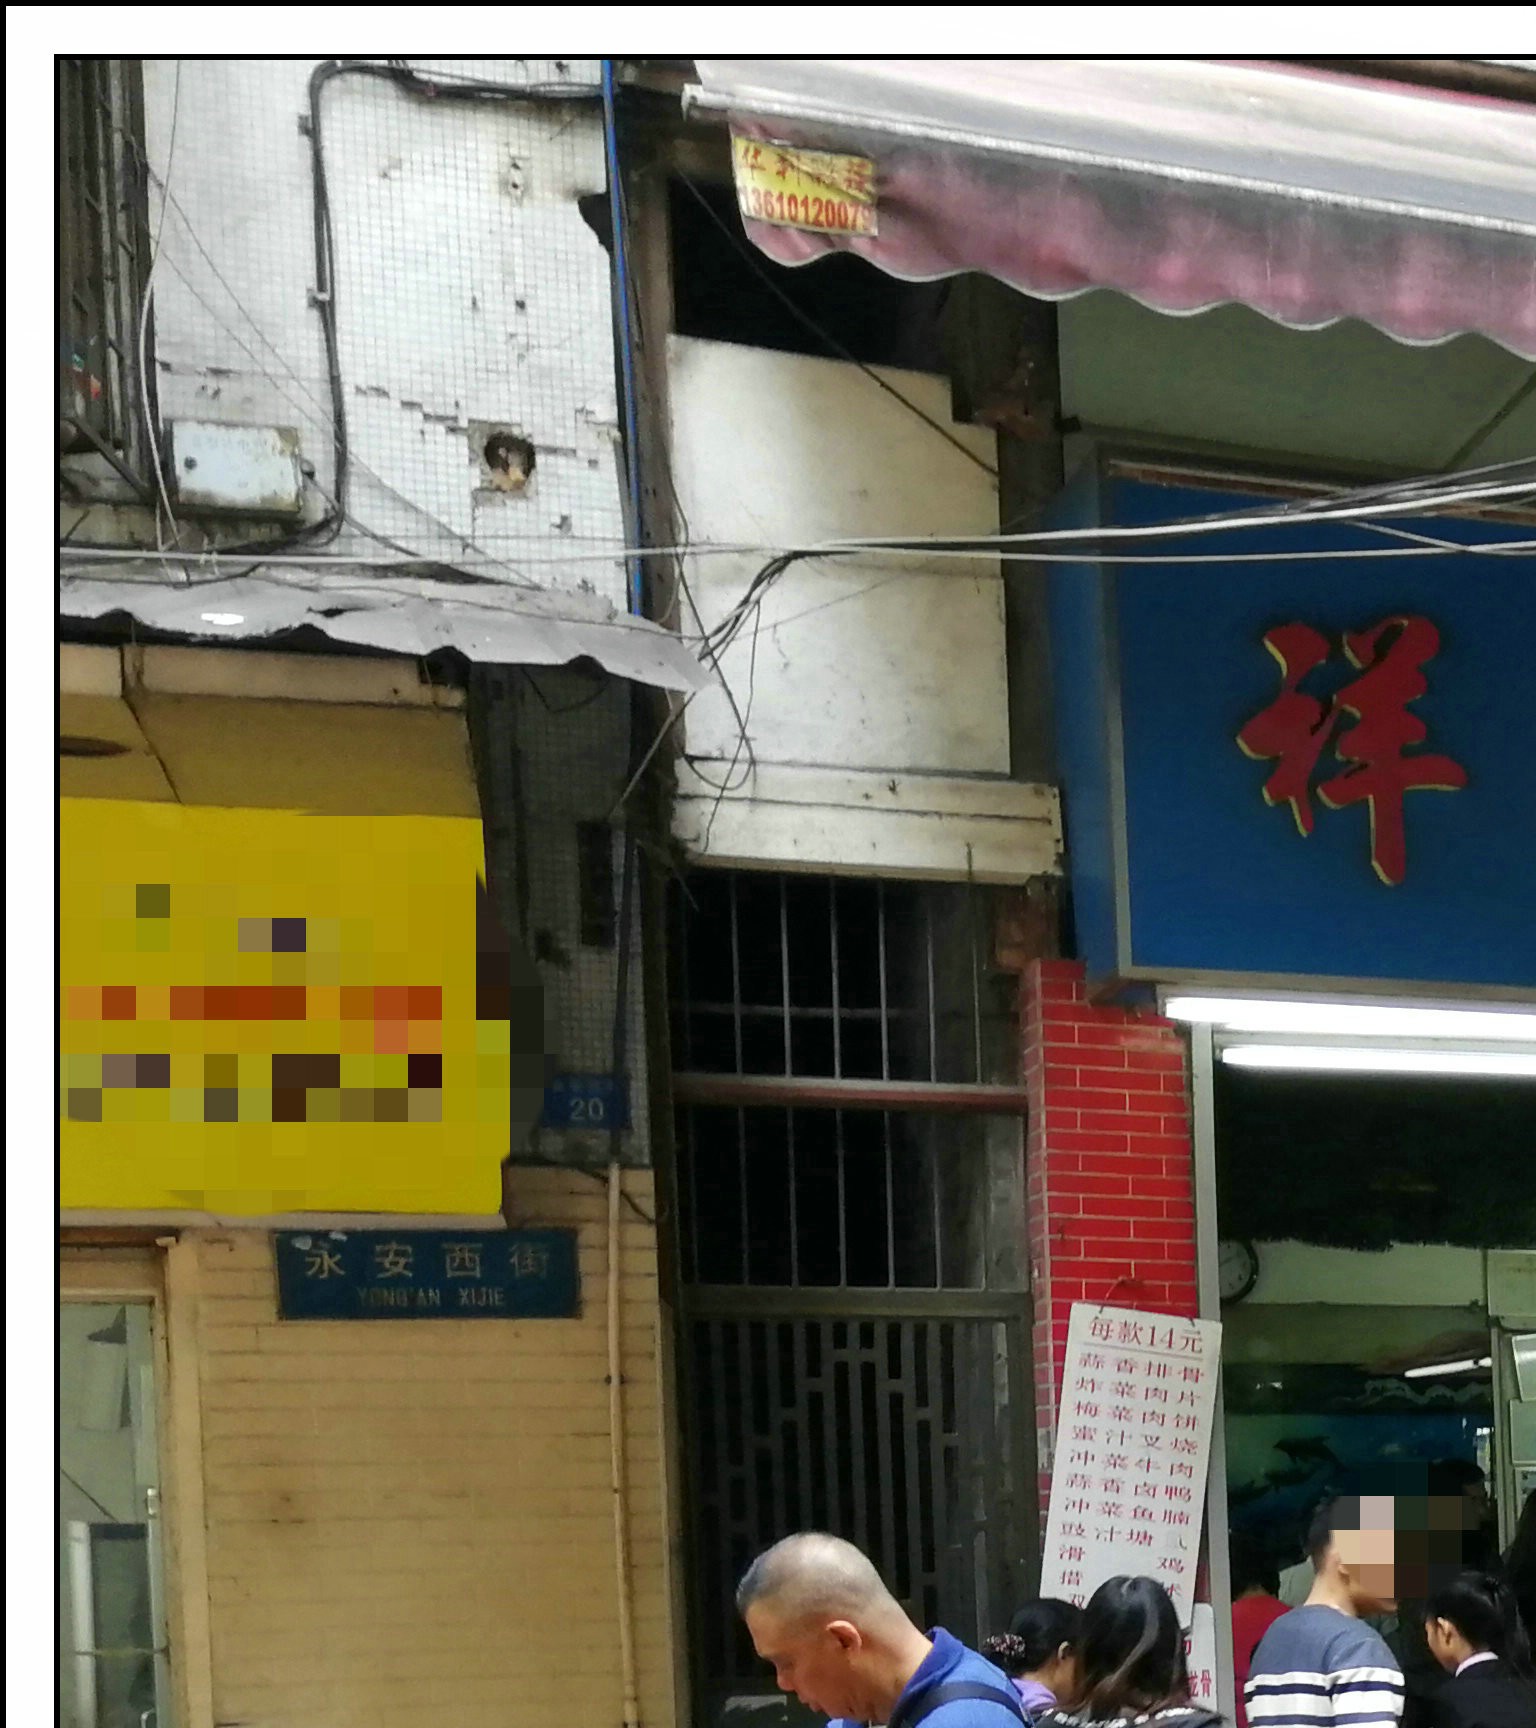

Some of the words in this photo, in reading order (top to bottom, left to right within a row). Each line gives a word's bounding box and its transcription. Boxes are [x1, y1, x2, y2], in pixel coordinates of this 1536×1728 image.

[570, 1097, 604, 1120] 20
[304, 1241, 548, 1280] 永安西街
[356, 1286, 441, 1307] YONG'AN
[458, 1286, 505, 1307] XIJIE
[1089, 1316, 1204, 1353] 每款14元
[1079, 1352, 1204, 1384] 蒜香排骨
[1074, 1400, 1200, 1431] 梅菜肉饼
[1072, 1425, 1198, 1456] 蜜汁叉烧
[1060, 1522, 1188, 1550] 豉汁塘
